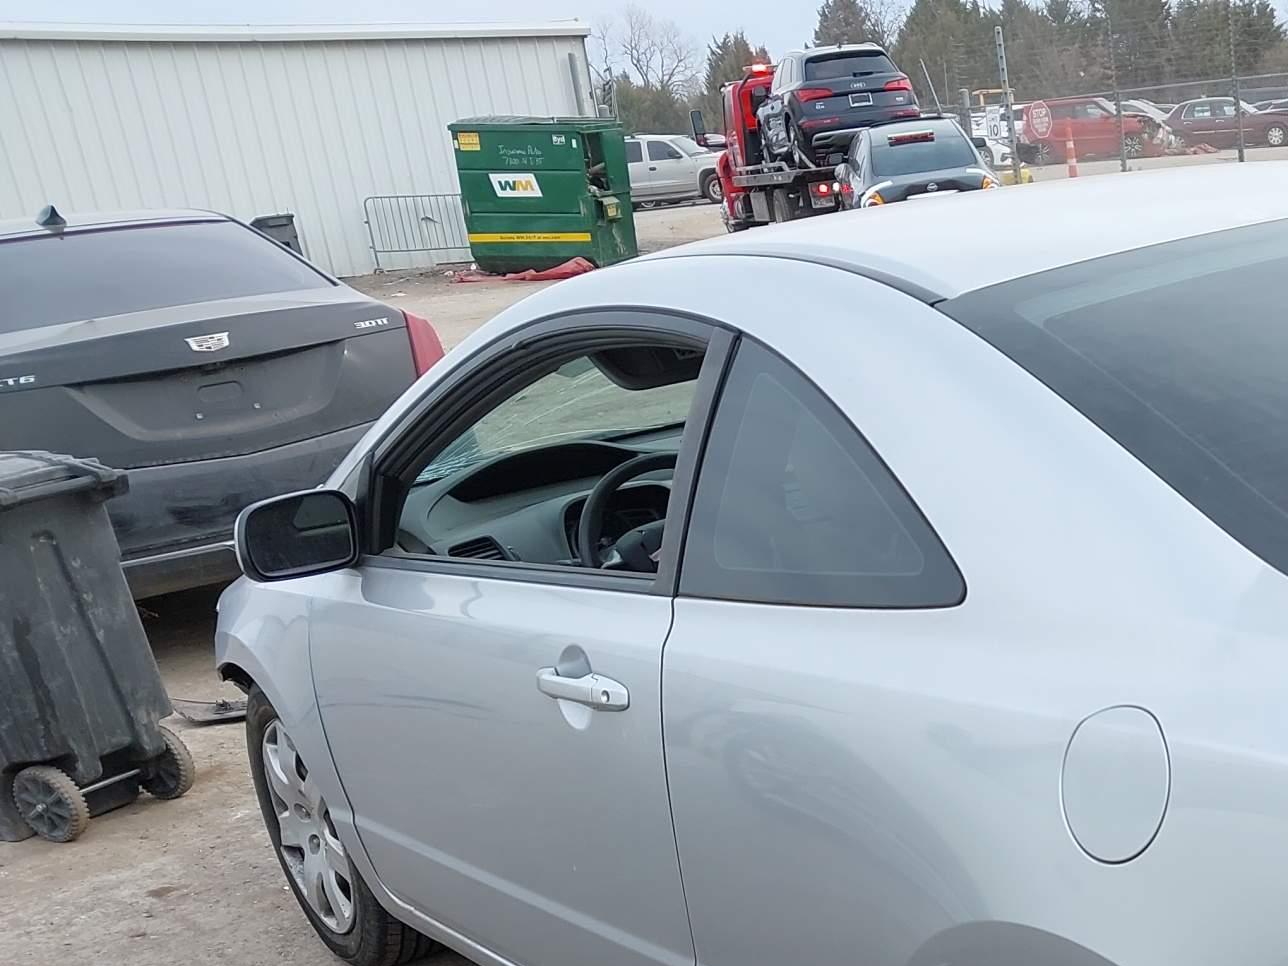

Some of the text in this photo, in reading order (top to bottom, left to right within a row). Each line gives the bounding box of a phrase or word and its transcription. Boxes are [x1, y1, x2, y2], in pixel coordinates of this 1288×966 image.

[1032, 107, 1046, 118] STOP
[989, 124, 999, 136] 10
[497, 180, 535, 191] WM
